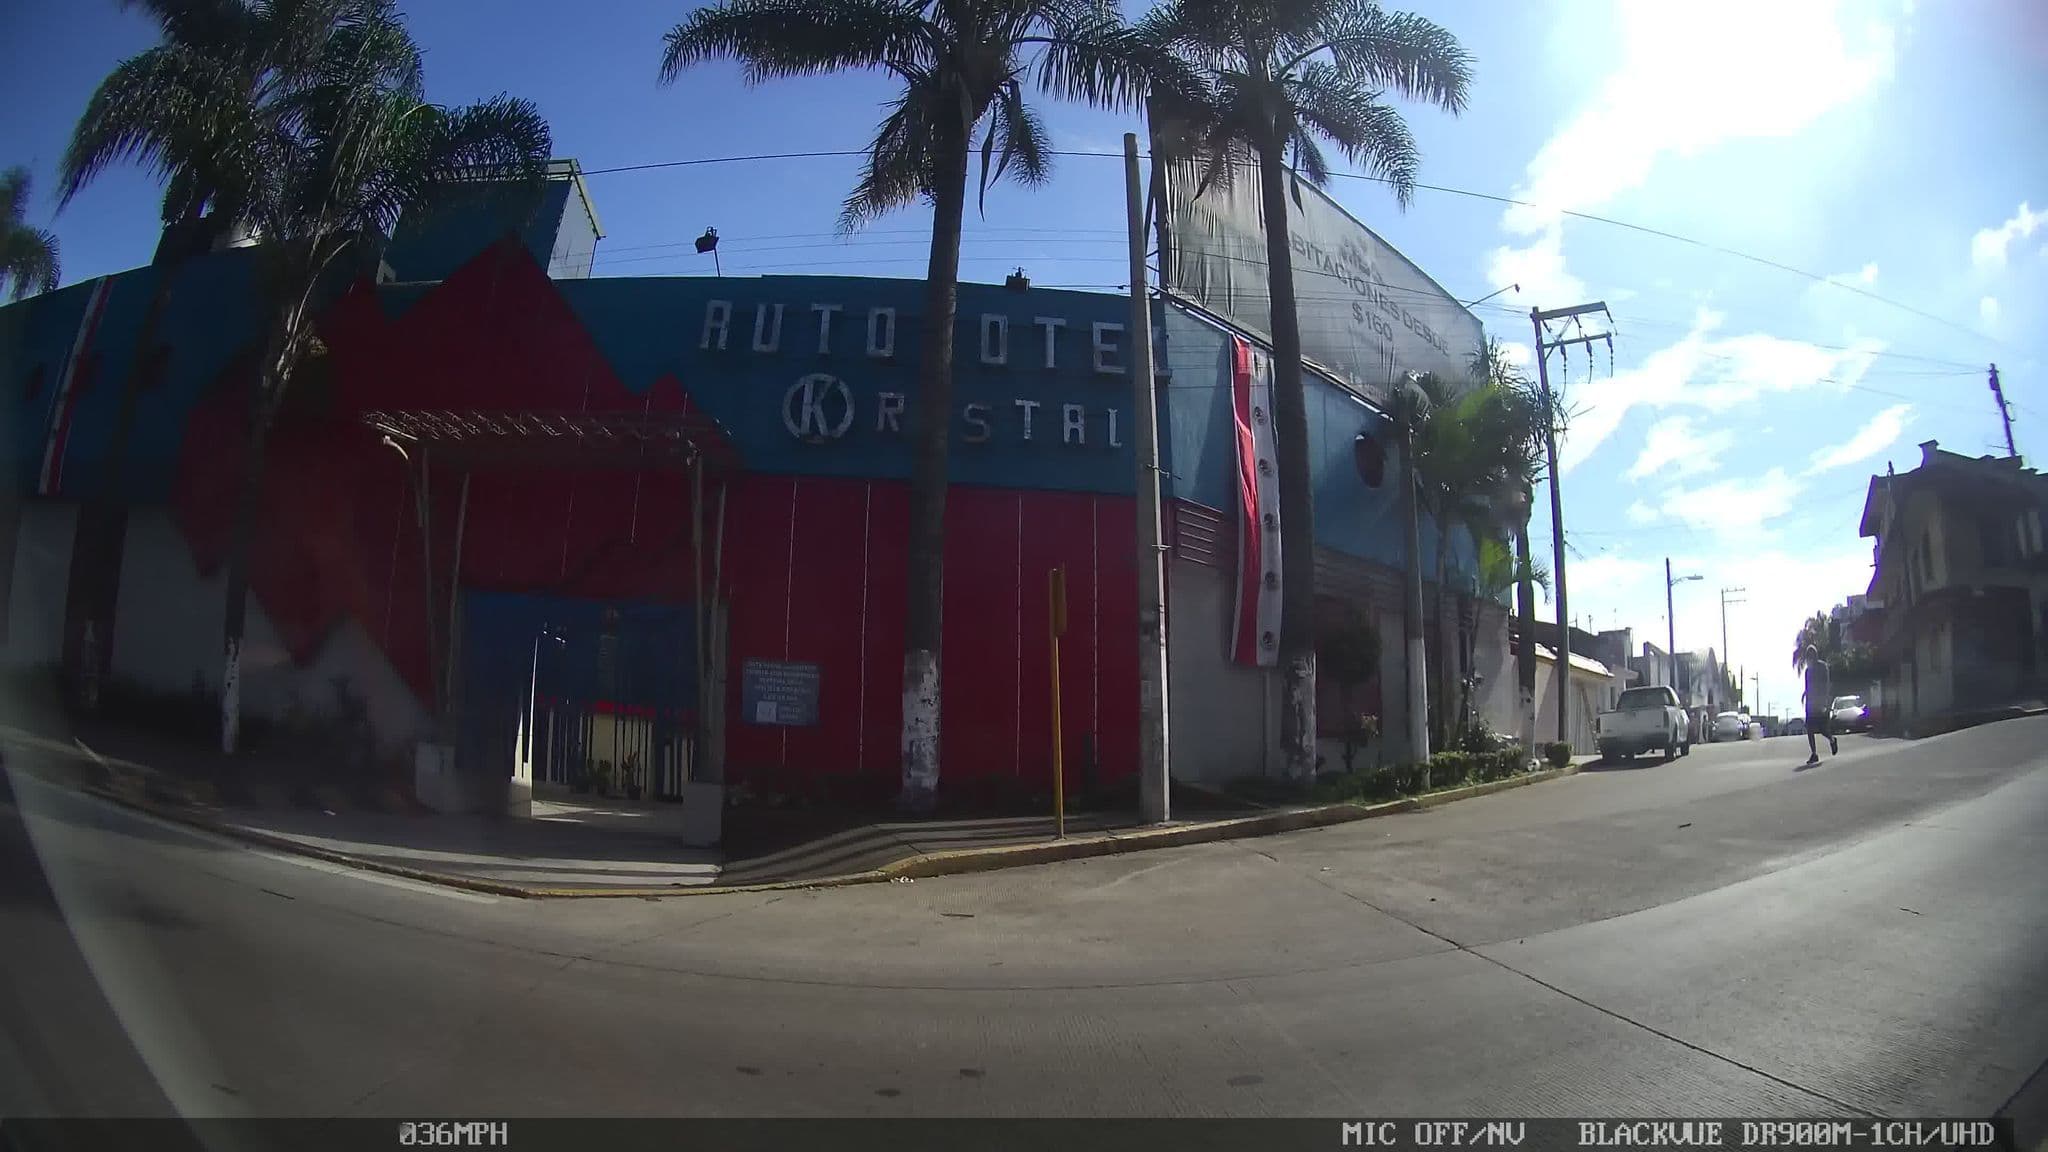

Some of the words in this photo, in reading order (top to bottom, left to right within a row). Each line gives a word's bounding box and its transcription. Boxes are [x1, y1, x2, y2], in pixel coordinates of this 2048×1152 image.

[699, 299, 896, 357] AUTO
[979, 312, 1172, 376] OTEL
[1351, 301, 1393, 342] $160
[1402, 309, 1449, 357] DESDE
[782, 373, 1123, 448] KRSTAL
